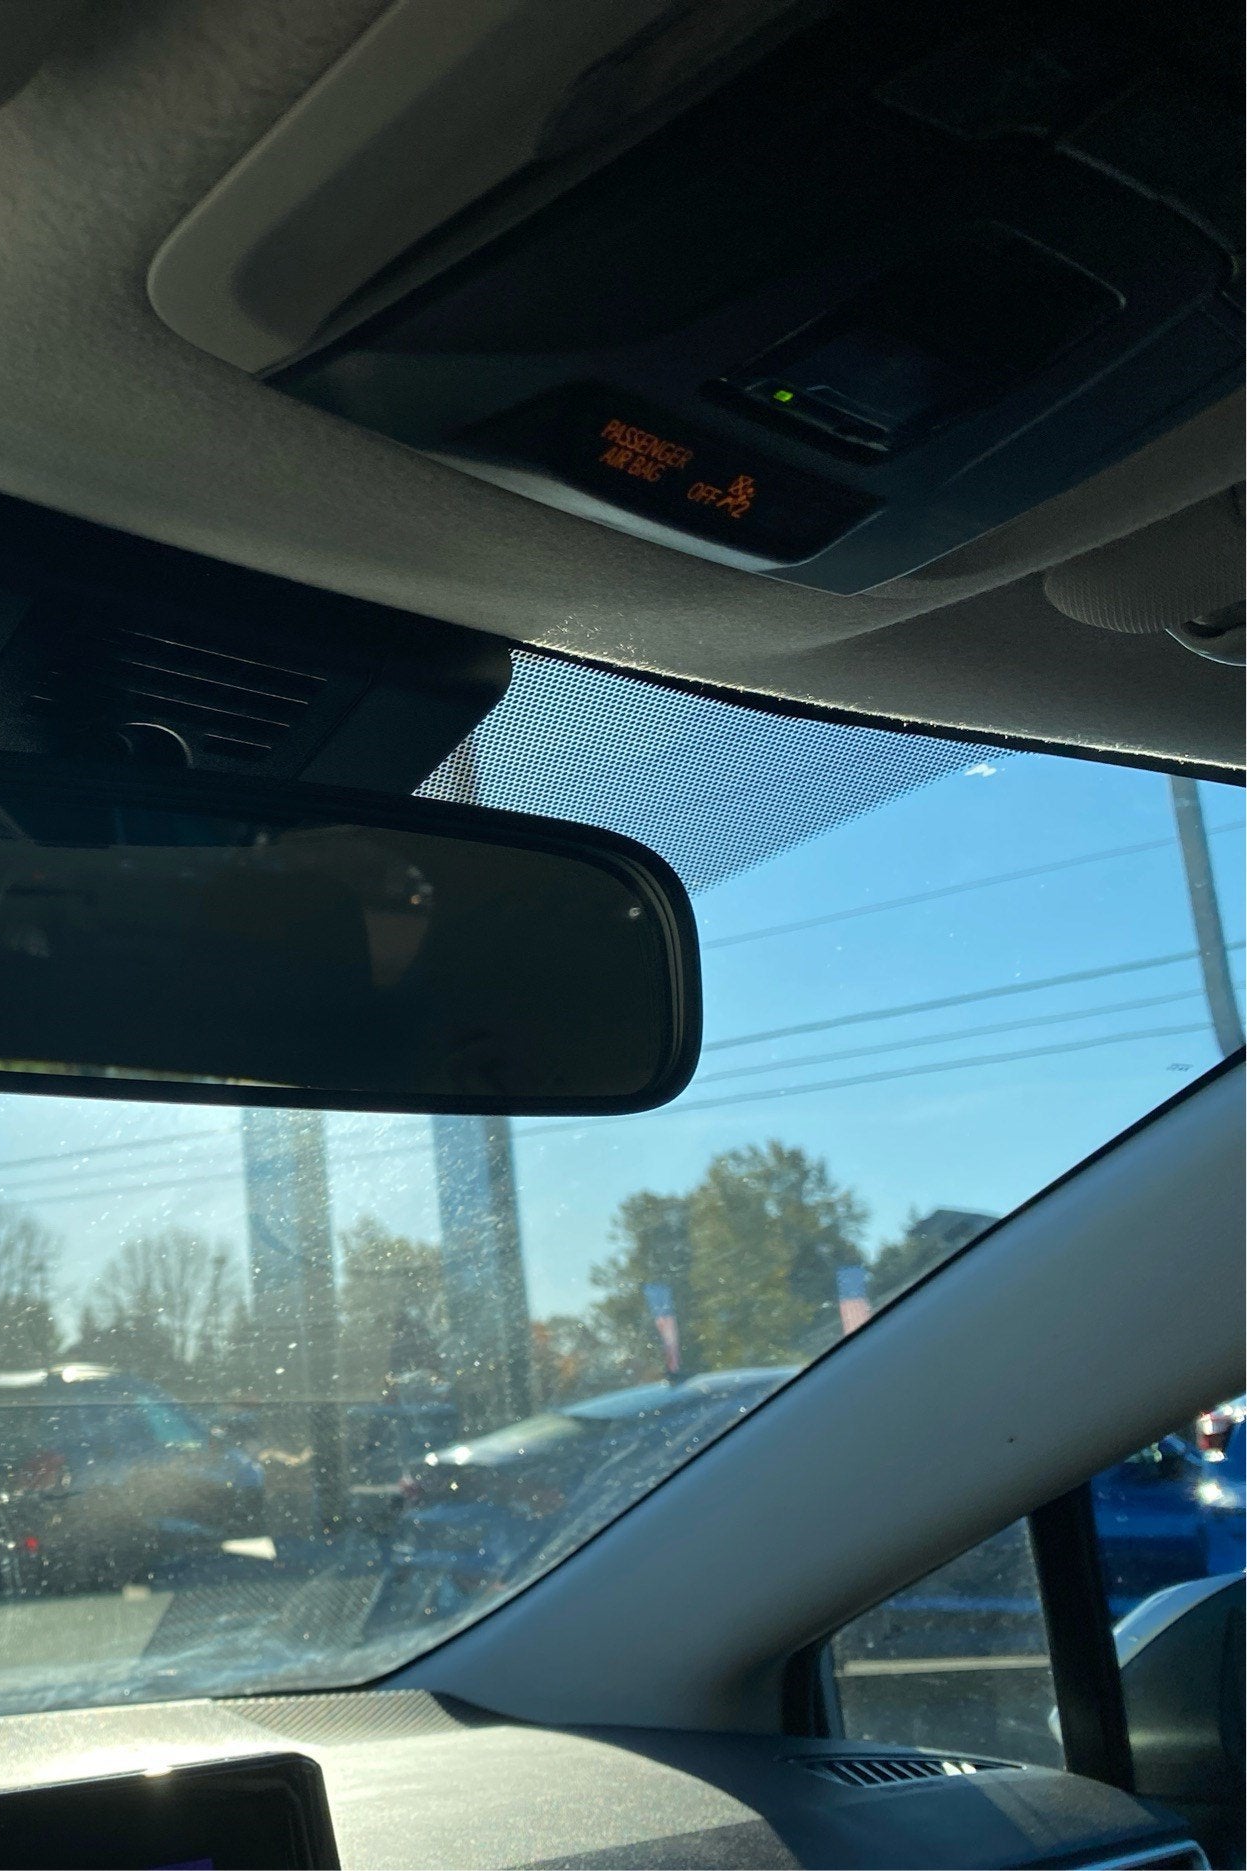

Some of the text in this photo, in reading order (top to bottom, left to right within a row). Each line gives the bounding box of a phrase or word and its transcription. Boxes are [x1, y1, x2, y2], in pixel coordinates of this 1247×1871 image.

[601, 419, 693, 469] PASSENGER
[600, 447, 664, 482] AIR BAG
[686, 482, 722, 504] OFF
